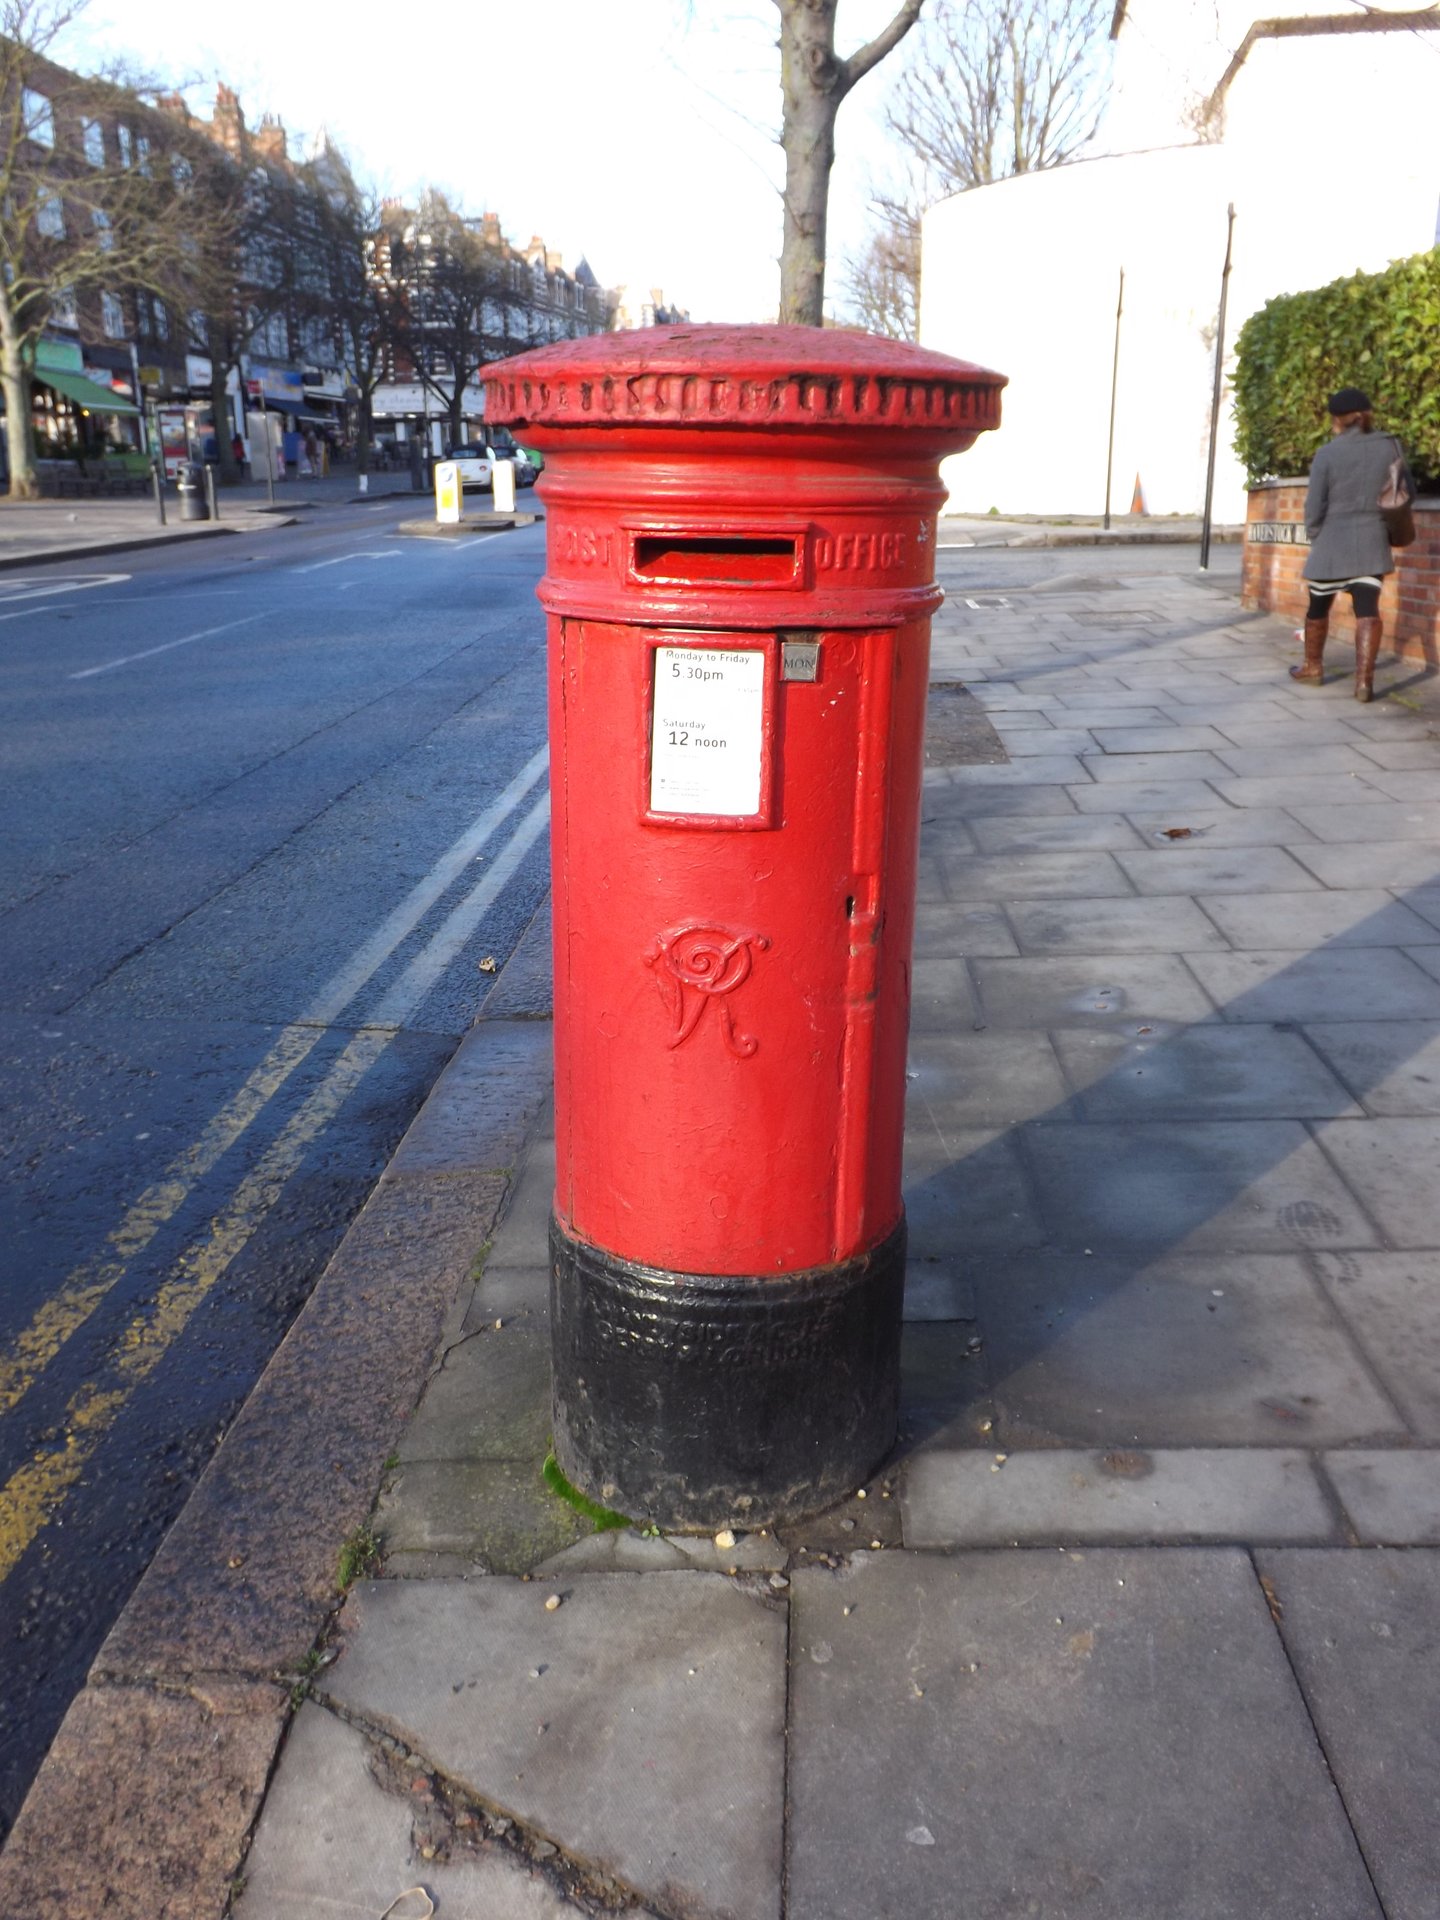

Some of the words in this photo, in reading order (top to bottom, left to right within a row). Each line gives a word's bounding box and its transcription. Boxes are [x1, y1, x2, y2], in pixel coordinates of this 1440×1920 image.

[556, 525, 615, 567] POST
[814, 531, 907, 571] OFFICE
[665, 649, 703, 664] Monday
[707, 653, 717, 663] to
[720, 652, 751, 665] Friday
[784, 659, 815, 669] MON
[662, 718, 706, 730] Saturday
[669, 731, 690, 747] 12
[695, 738, 727, 749] noon
